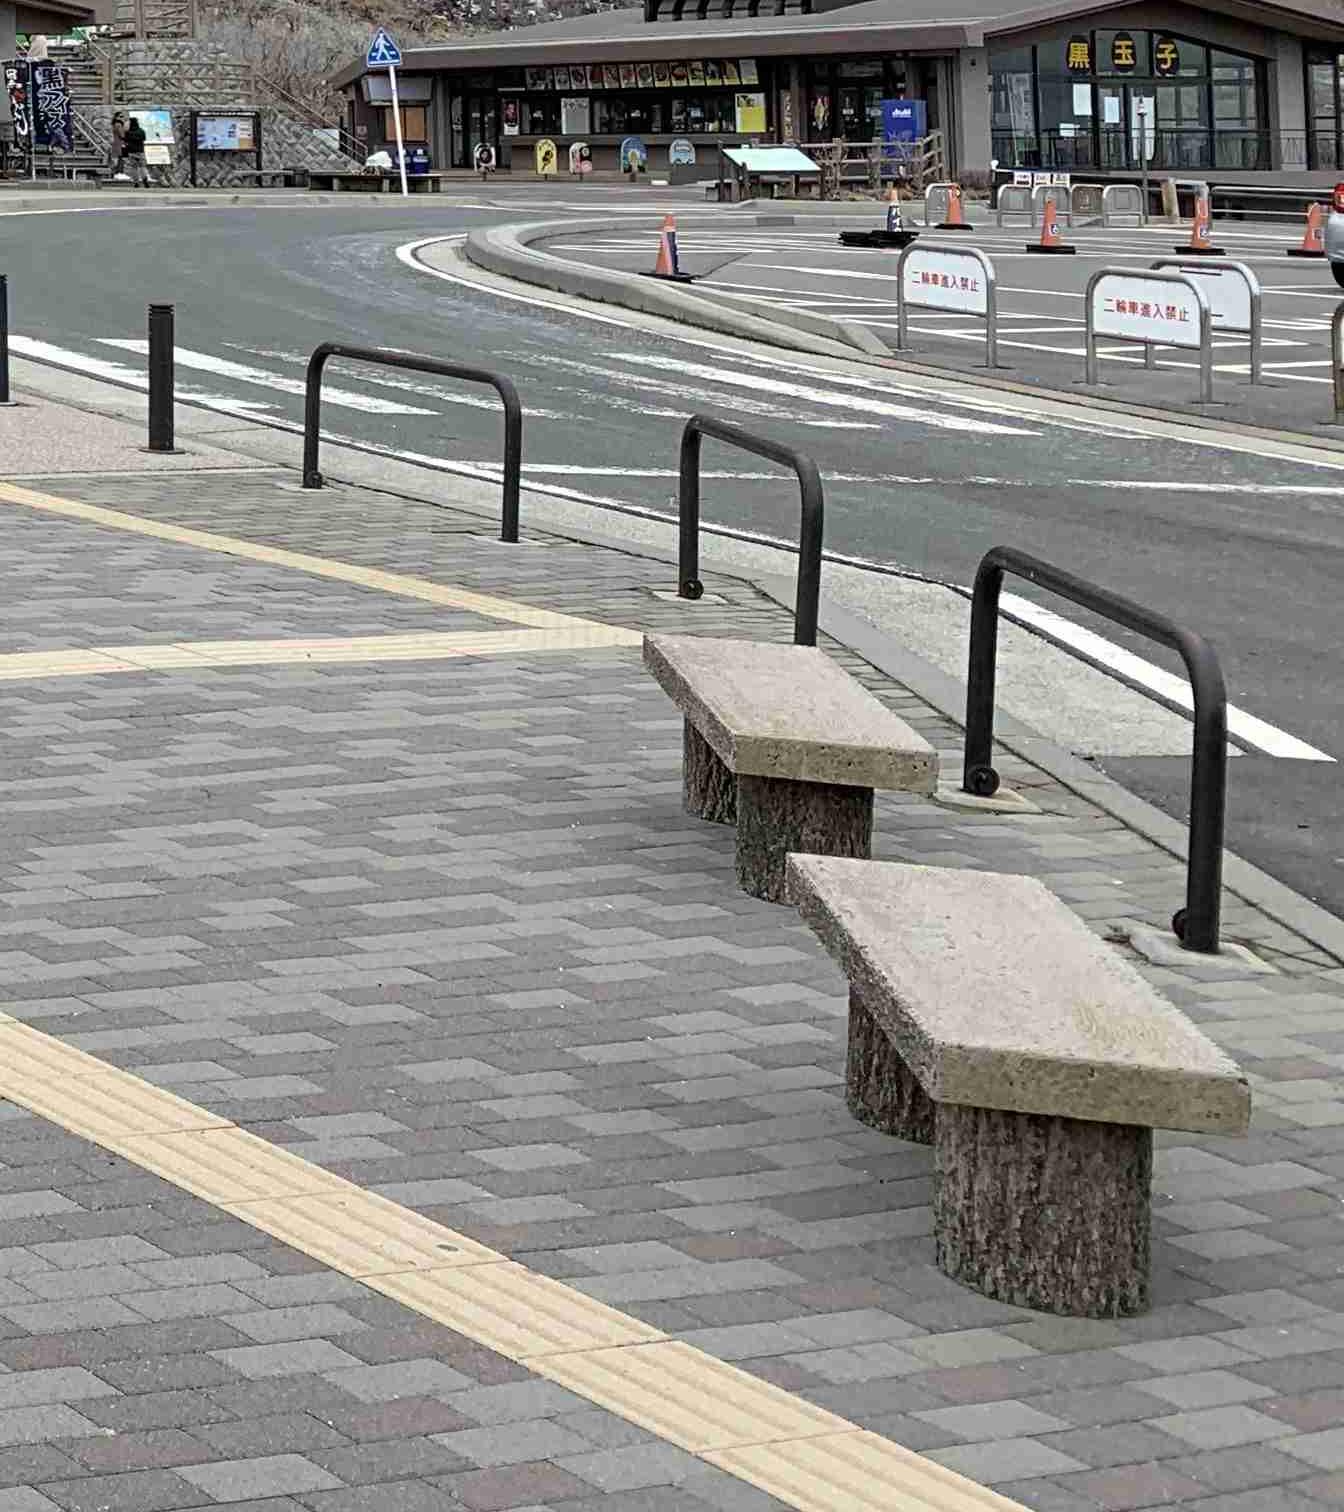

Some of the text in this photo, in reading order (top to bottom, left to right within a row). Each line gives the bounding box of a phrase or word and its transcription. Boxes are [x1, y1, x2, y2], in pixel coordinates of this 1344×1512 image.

[1068, 40, 1178, 69] 黒玉子
[911, 270, 980, 293] 二輪車進入禁止
[1103, 297, 1190, 322] 二輪車進入禁止
